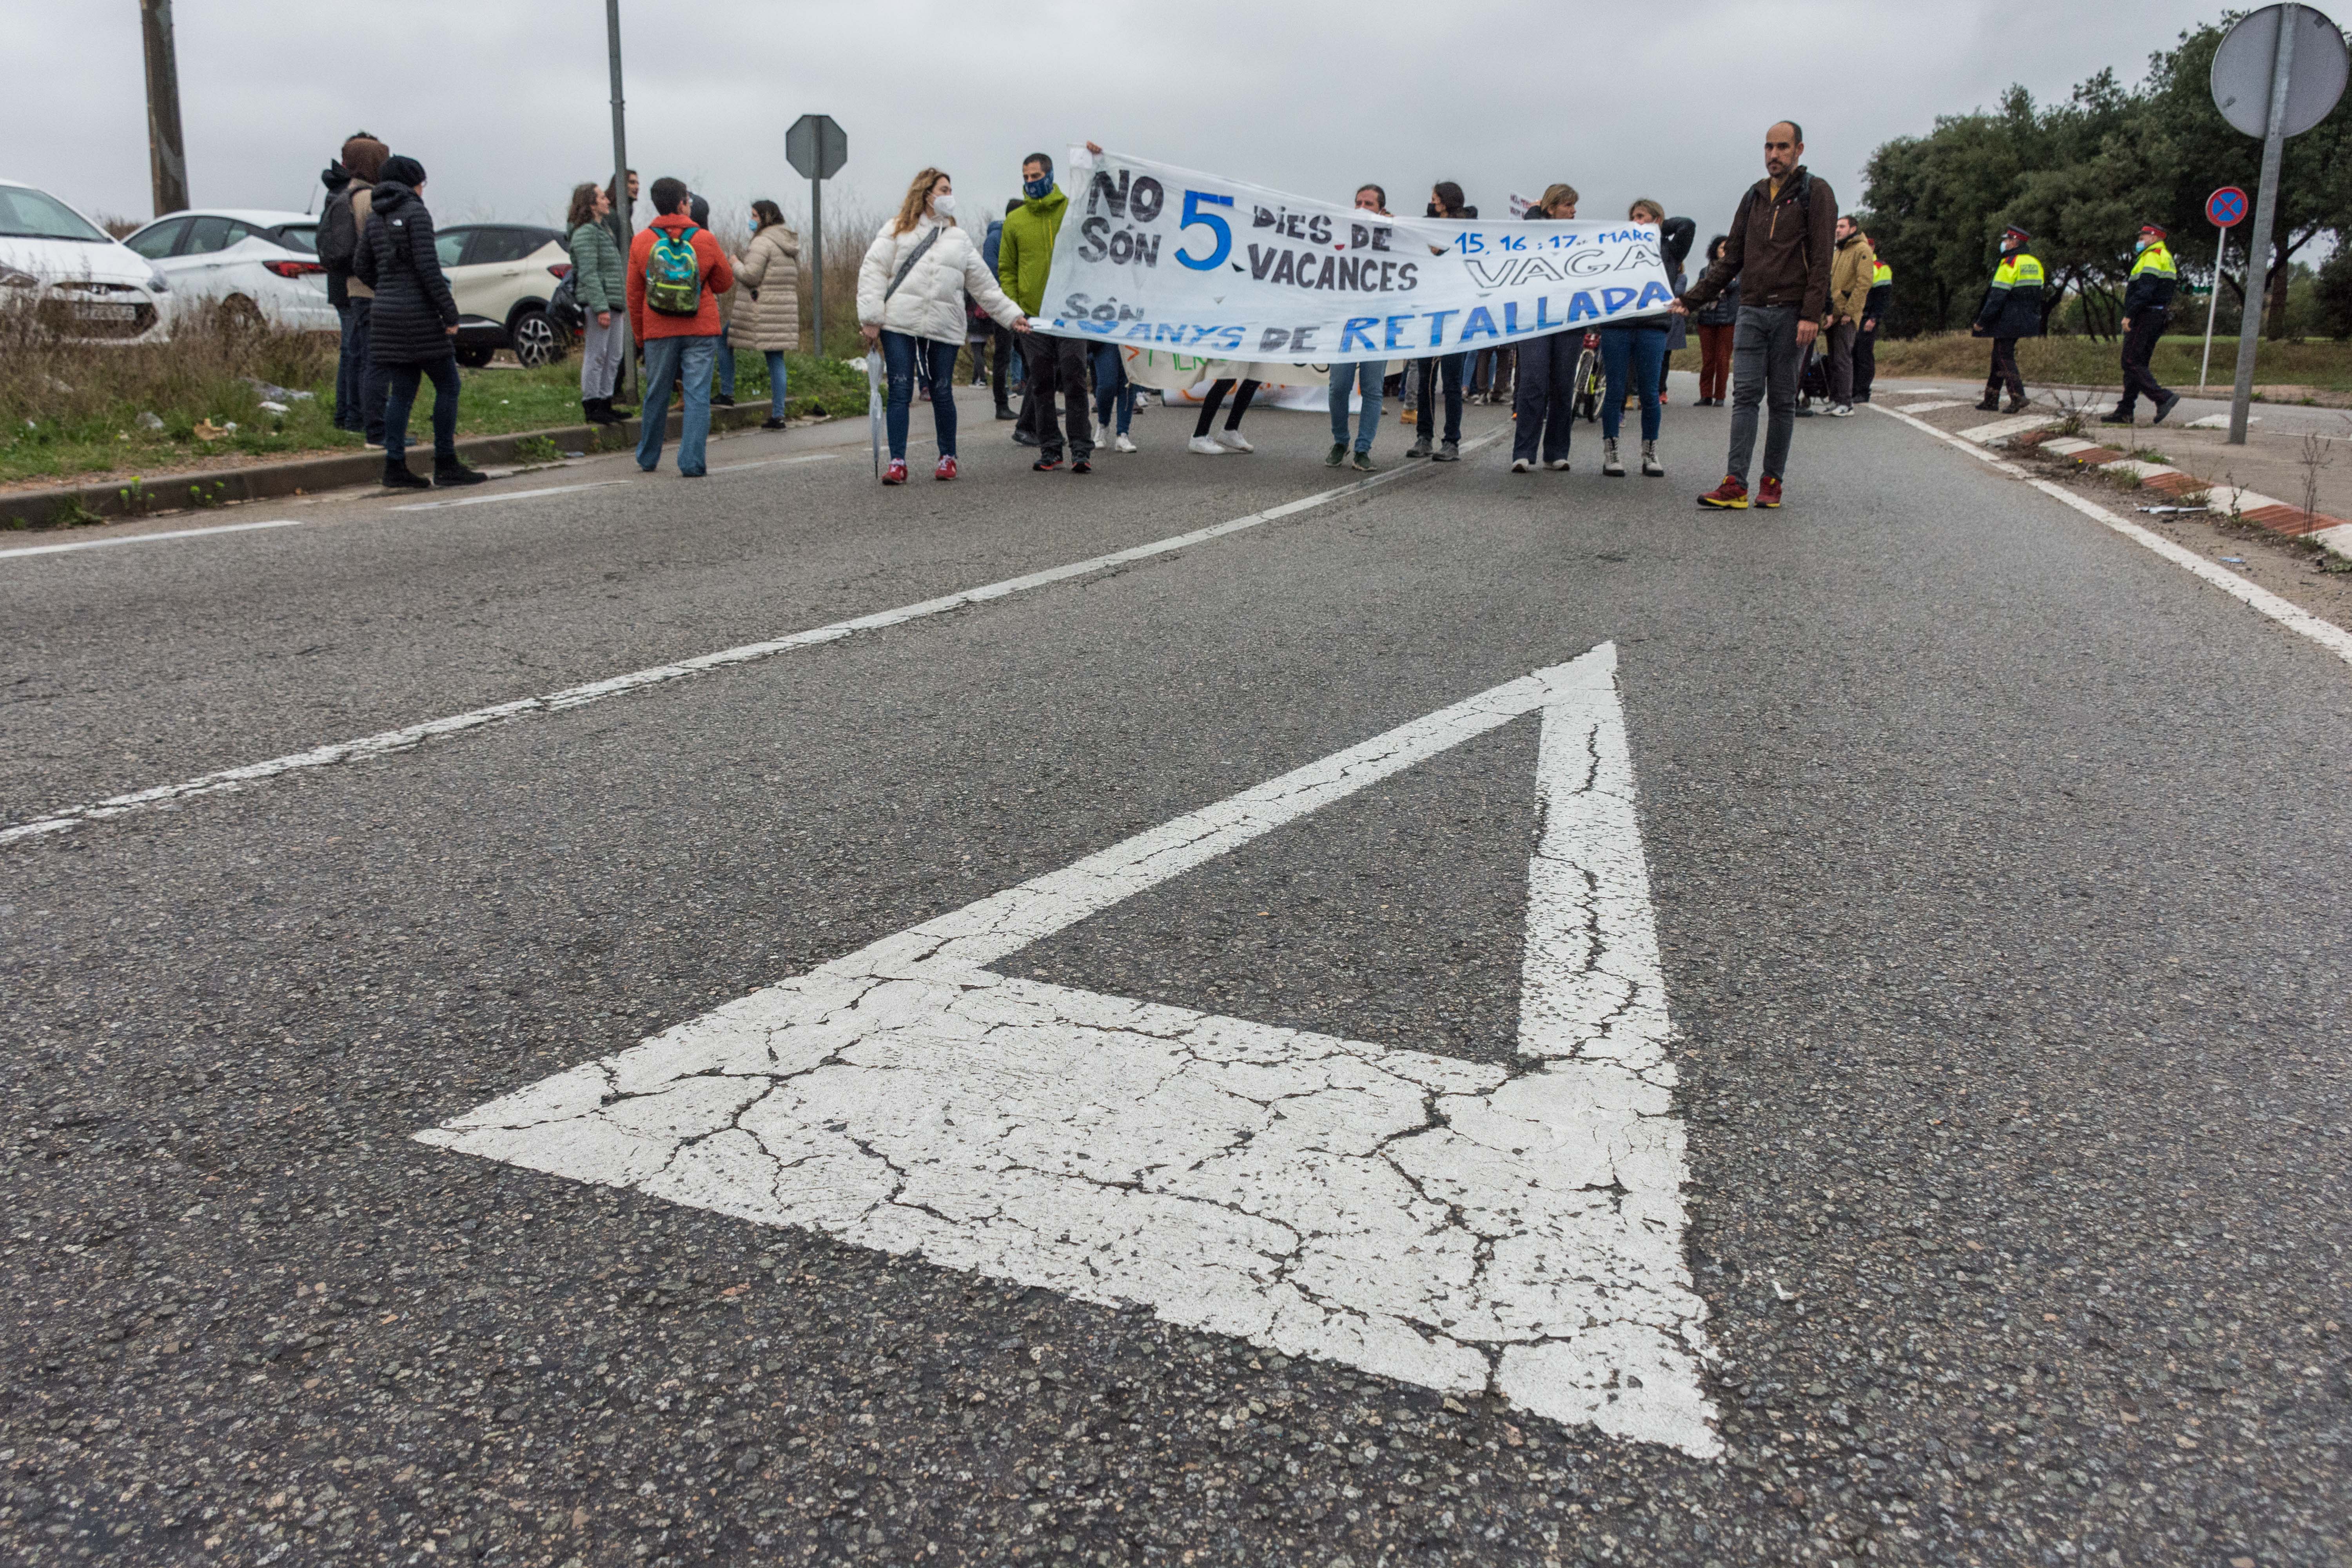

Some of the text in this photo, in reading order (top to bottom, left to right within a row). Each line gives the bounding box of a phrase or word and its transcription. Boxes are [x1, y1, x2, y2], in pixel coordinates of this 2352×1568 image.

[1087, 170, 1164, 223] NO
[1078, 217, 1161, 269] SÓN
[1174, 189, 1234, 271] 5
[1351, 224, 1392, 252] DE
[1500, 235, 1527, 251] 16
[1549, 235, 1577, 248] 17
[1247, 243, 1419, 292] VACANCES
[1464, 244, 1662, 289] VAGA
[1258, 326, 1321, 353] DE
[1339, 281, 1673, 353] RETALLADA
